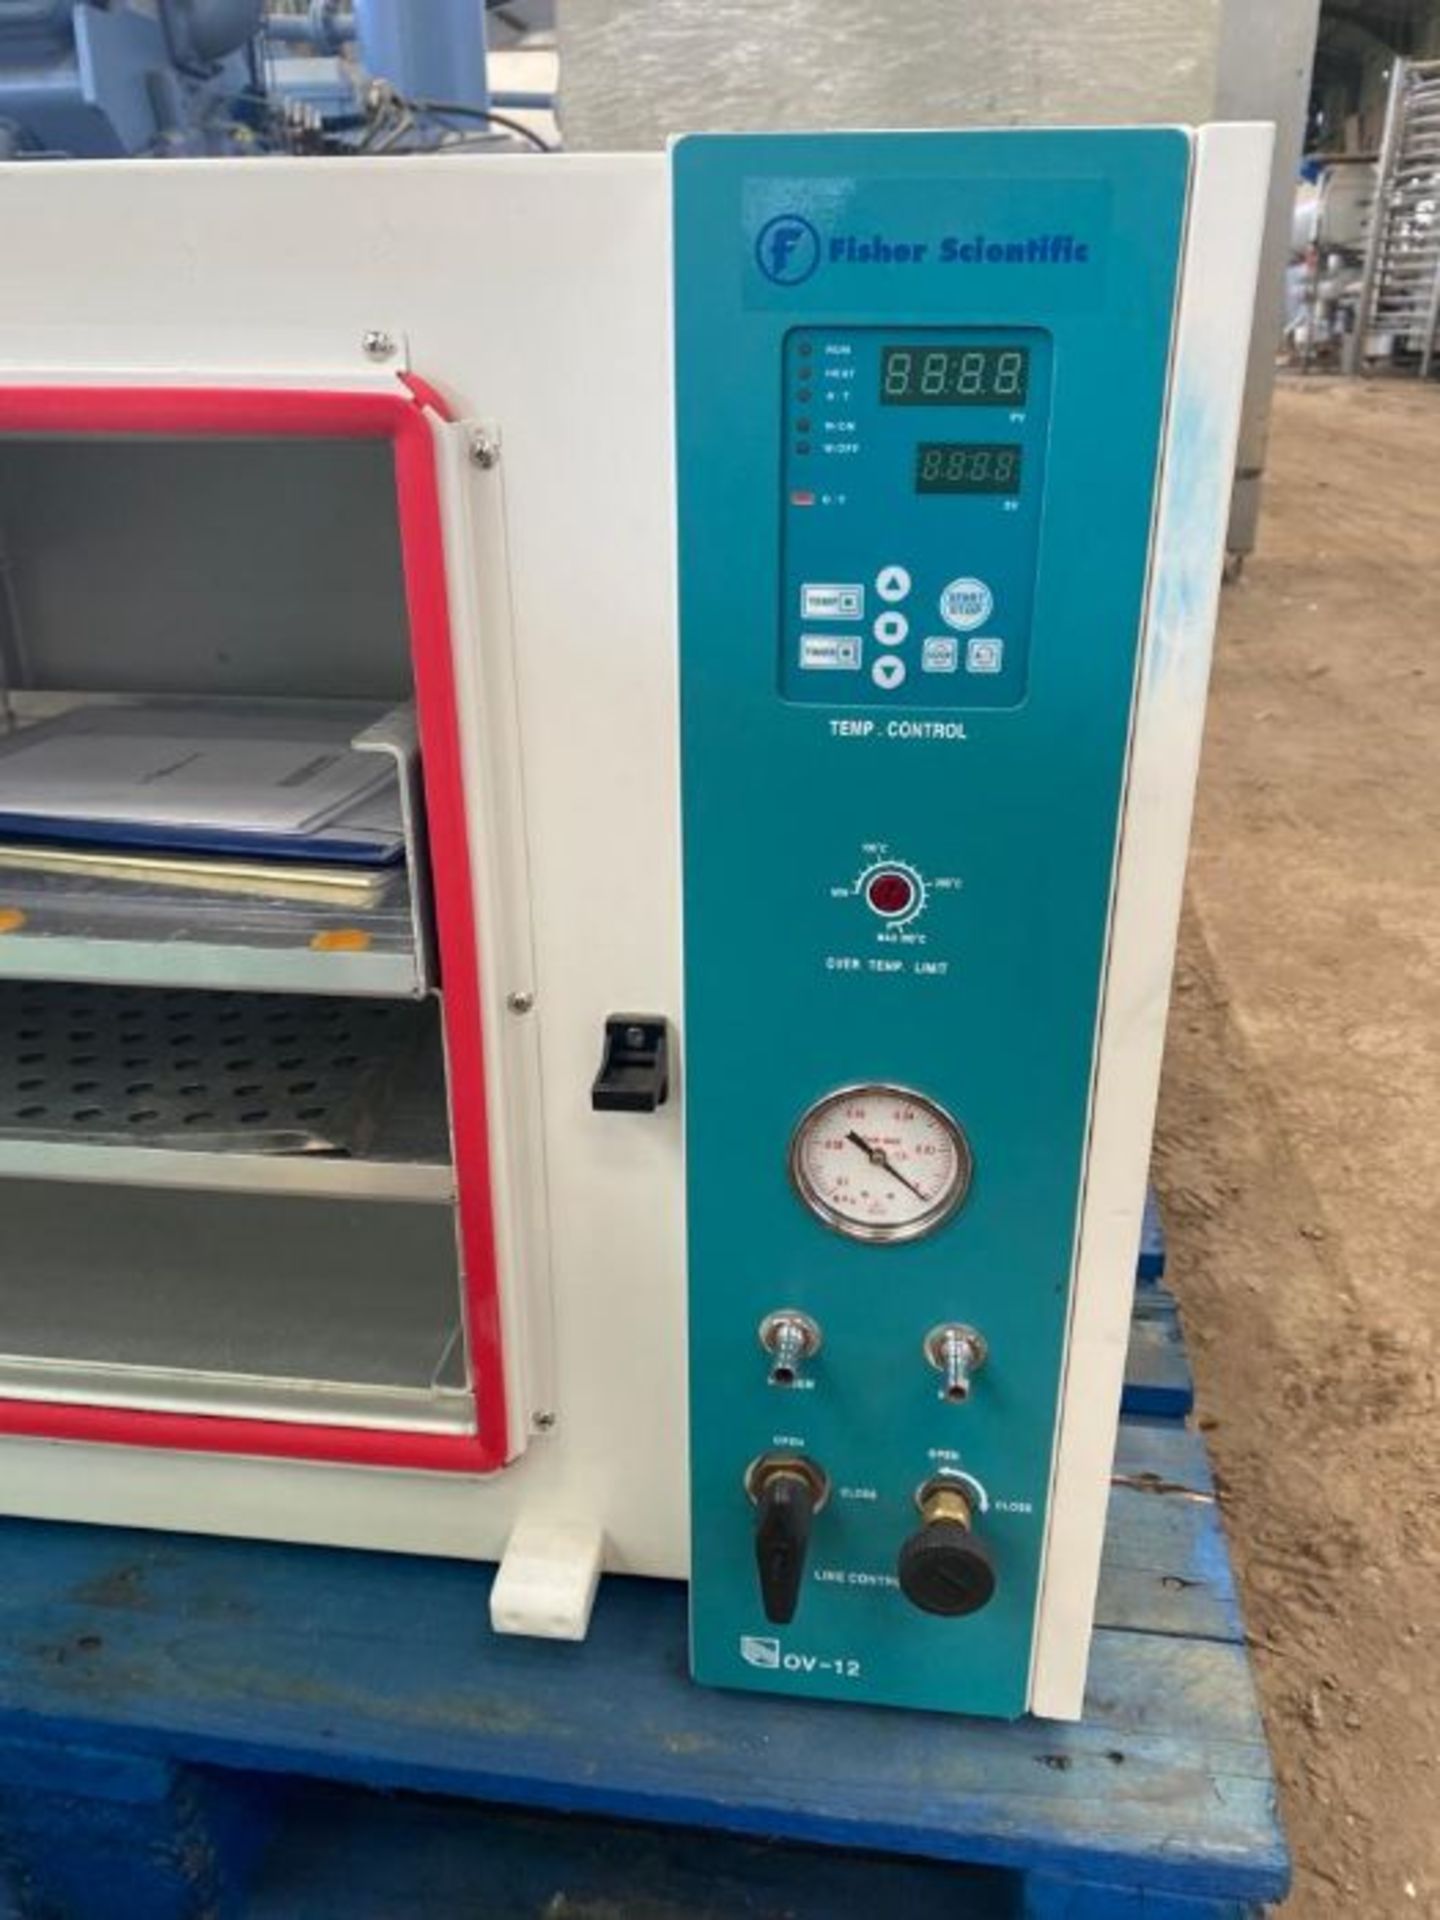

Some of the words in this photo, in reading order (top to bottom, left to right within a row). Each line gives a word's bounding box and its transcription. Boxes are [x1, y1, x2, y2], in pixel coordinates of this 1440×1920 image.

[829, 236, 928, 263] Fisher
[938, 235, 1090, 263] Scientific
[830, 720, 874, 737] TEMP
[887, 720, 966, 739] CONTROL
[825, 956, 861, 970] OVER
[914, 961, 949, 975] LIMIT
[928, 1448, 960, 1460] OPEN
[995, 1501, 1032, 1513] CLOSE
[783, 1653, 861, 1677] OV-12
